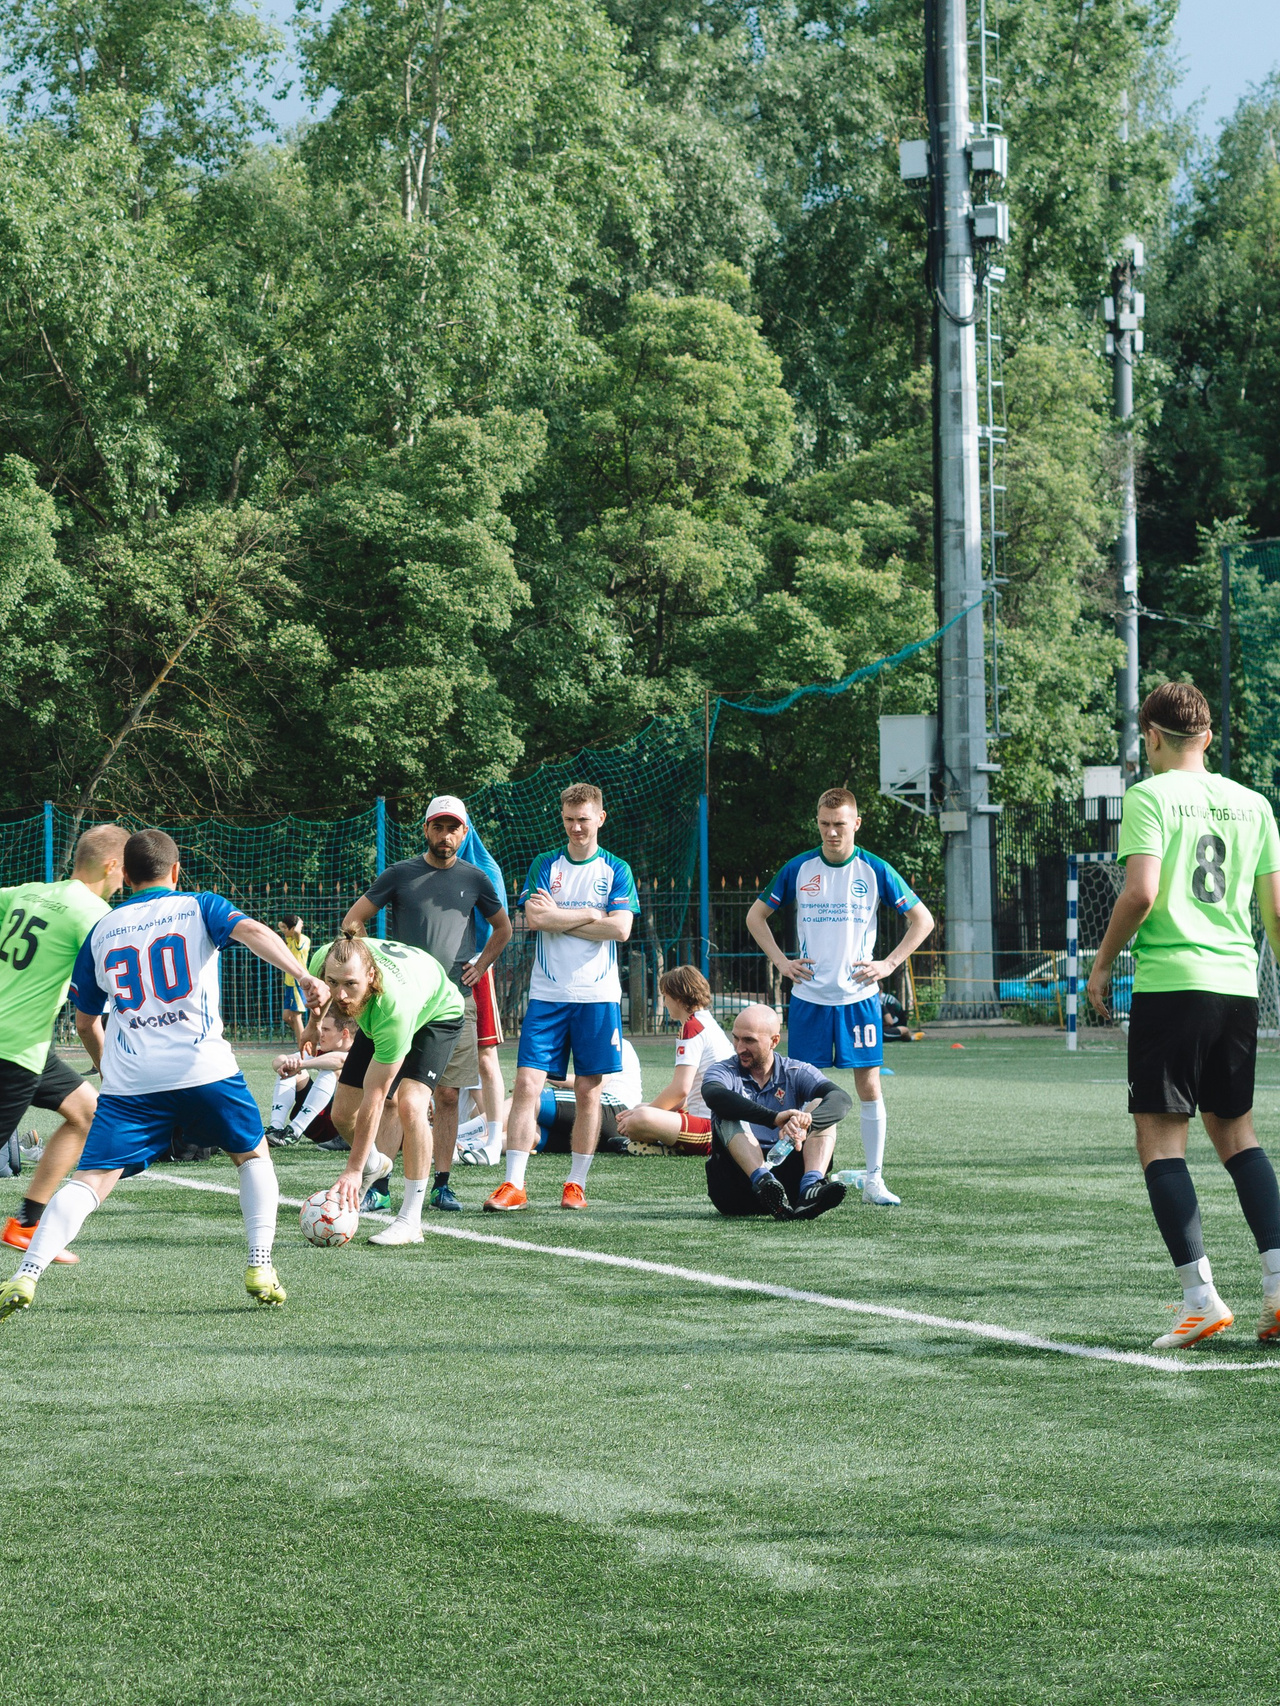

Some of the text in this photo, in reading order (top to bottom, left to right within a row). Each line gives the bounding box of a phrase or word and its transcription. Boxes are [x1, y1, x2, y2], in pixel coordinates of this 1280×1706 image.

[1191, 834, 1226, 904] 8
[104, 932, 193, 1015] 30
[129, 1009, 190, 1030] МОСКВА
[610, 1027, 621, 1052] 4
[852, 1023, 877, 1048] 10
